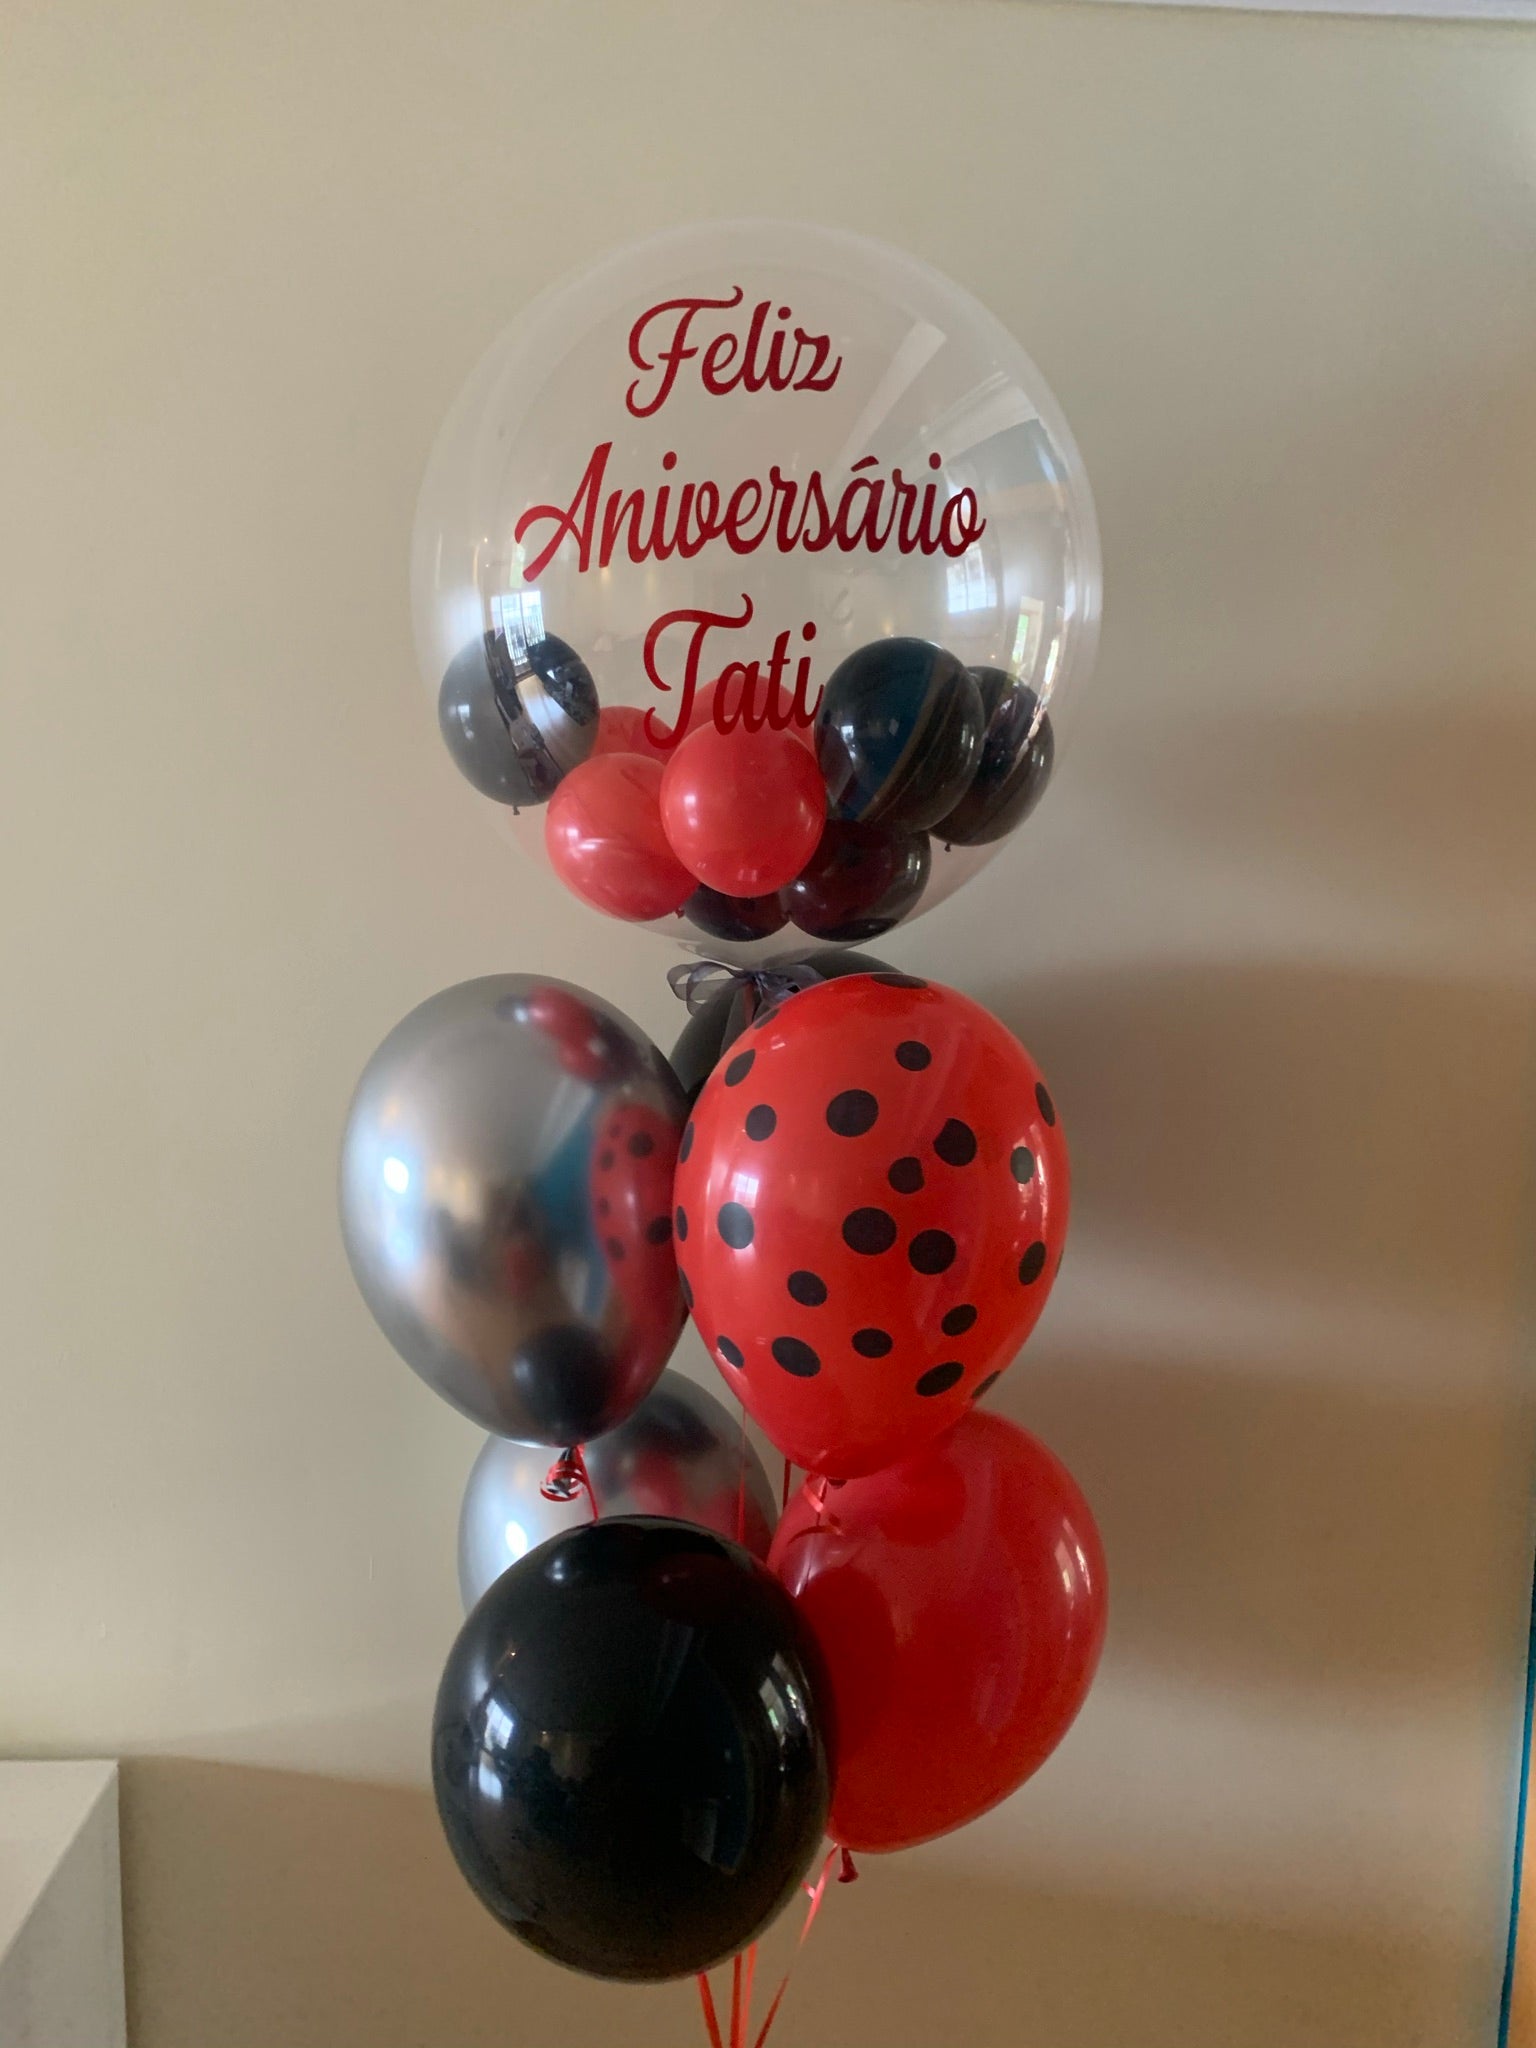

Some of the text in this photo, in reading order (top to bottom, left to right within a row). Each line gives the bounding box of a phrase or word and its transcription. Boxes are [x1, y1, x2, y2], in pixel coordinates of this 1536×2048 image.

[626, 285, 842, 418] Feliz
[514, 441, 986, 583] Aniversário
[643, 593, 824, 750] Tati
